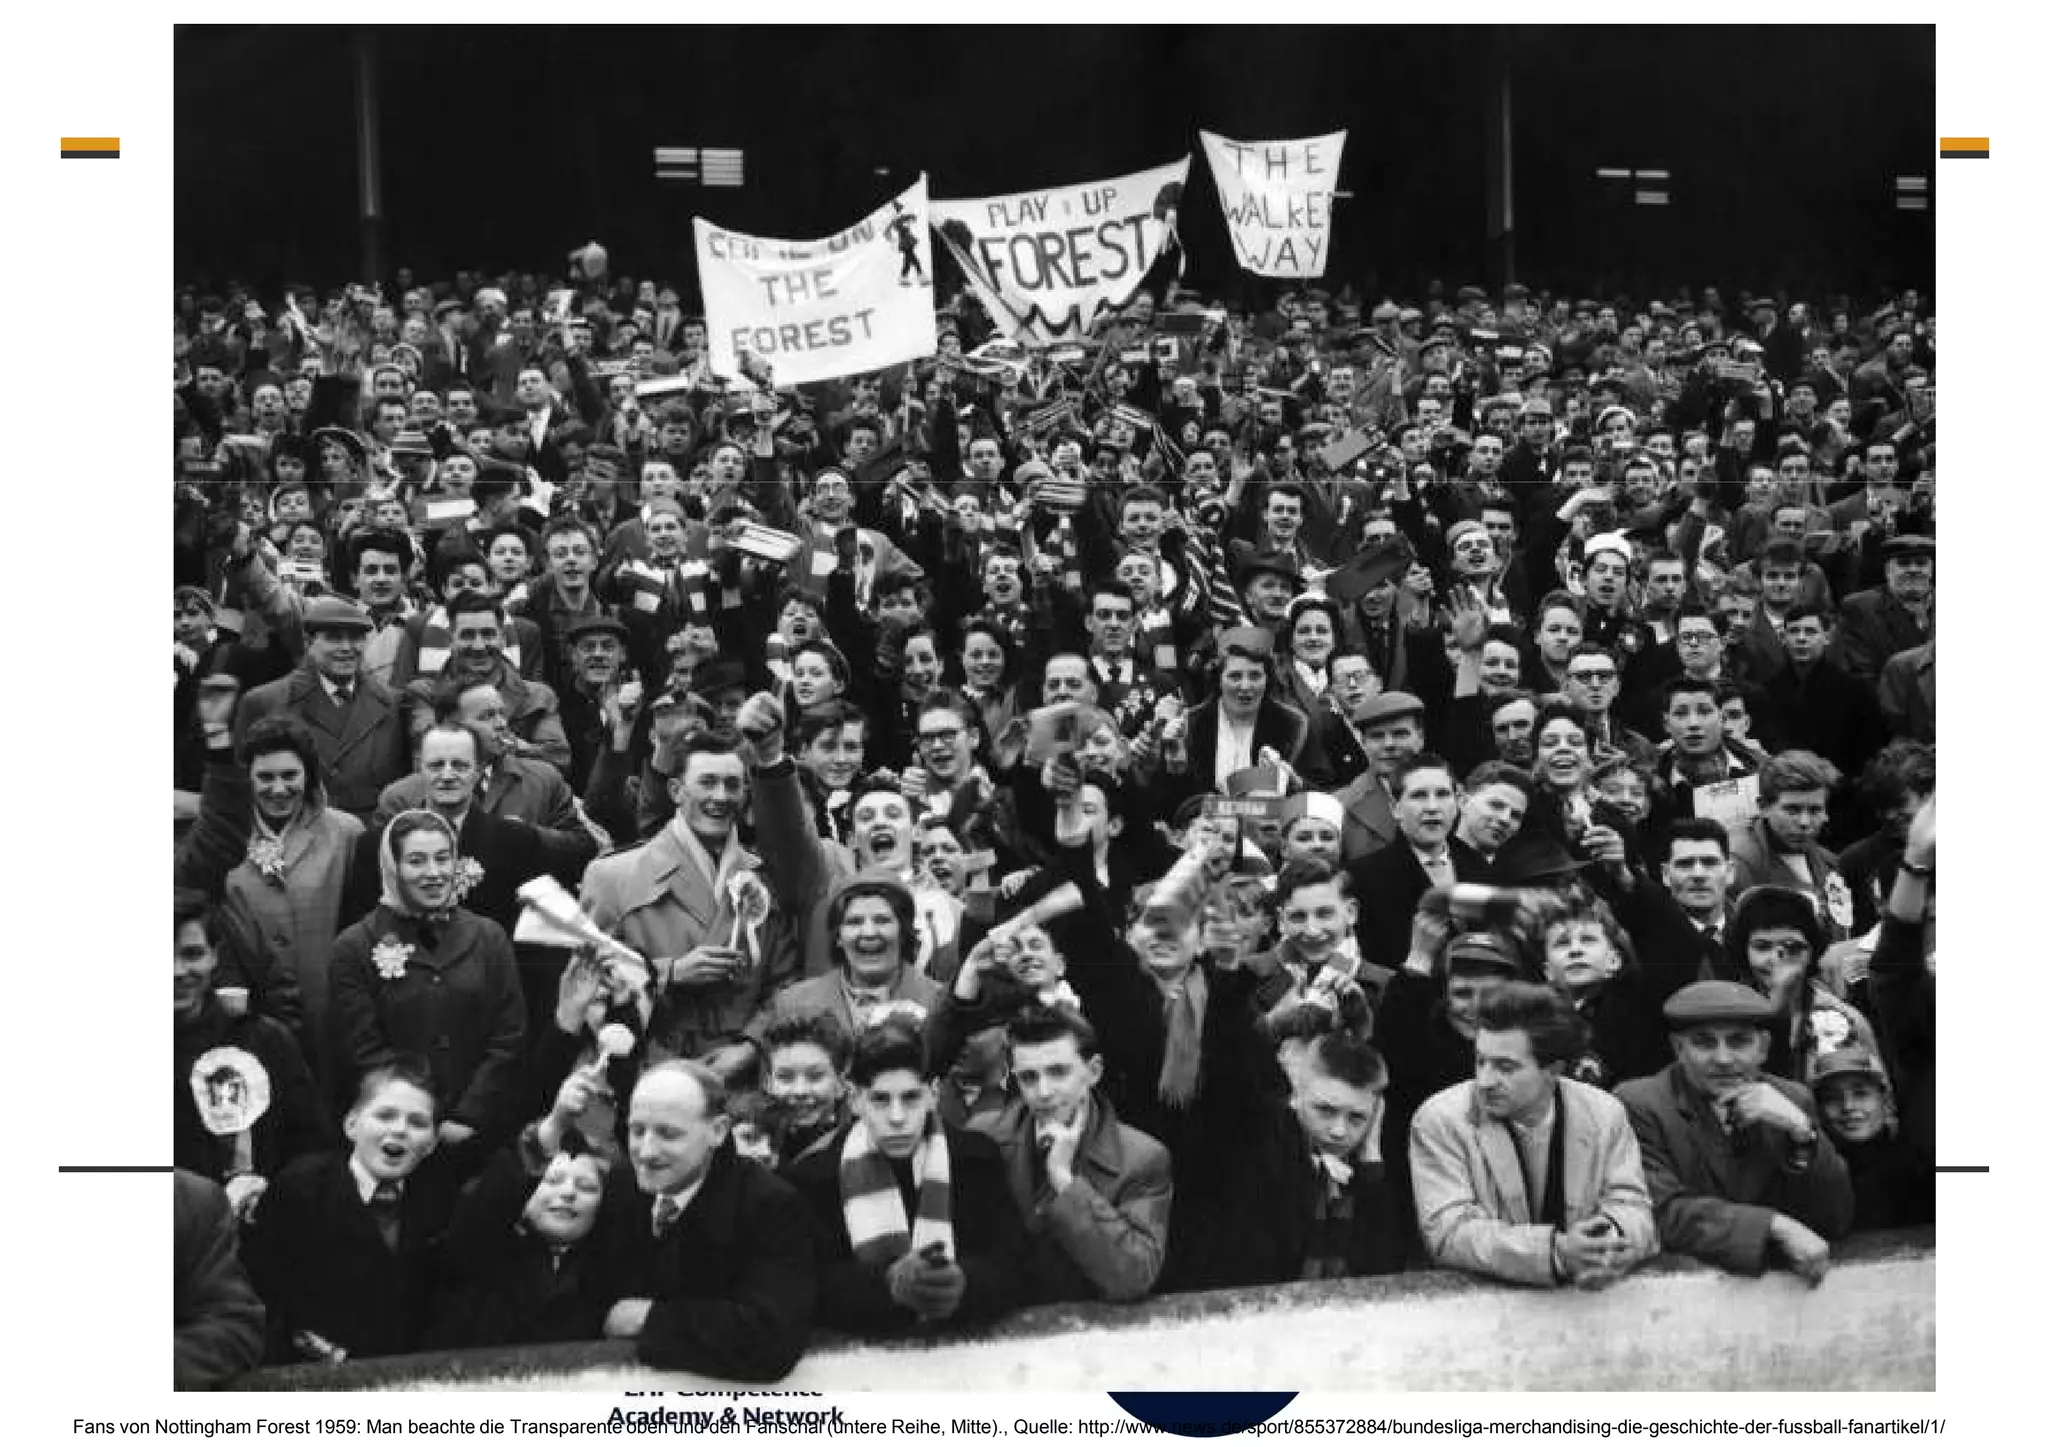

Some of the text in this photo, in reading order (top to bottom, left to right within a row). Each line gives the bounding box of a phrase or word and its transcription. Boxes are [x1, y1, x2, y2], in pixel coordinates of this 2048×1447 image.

[1223, 143, 1325, 180] THE
[986, 187, 1118, 228] PLAY UP
[978, 213, 1153, 294] FOREST
[1234, 232, 1322, 271] WAY
[757, 268, 839, 307] THE
[730, 307, 876, 357] FOREST
